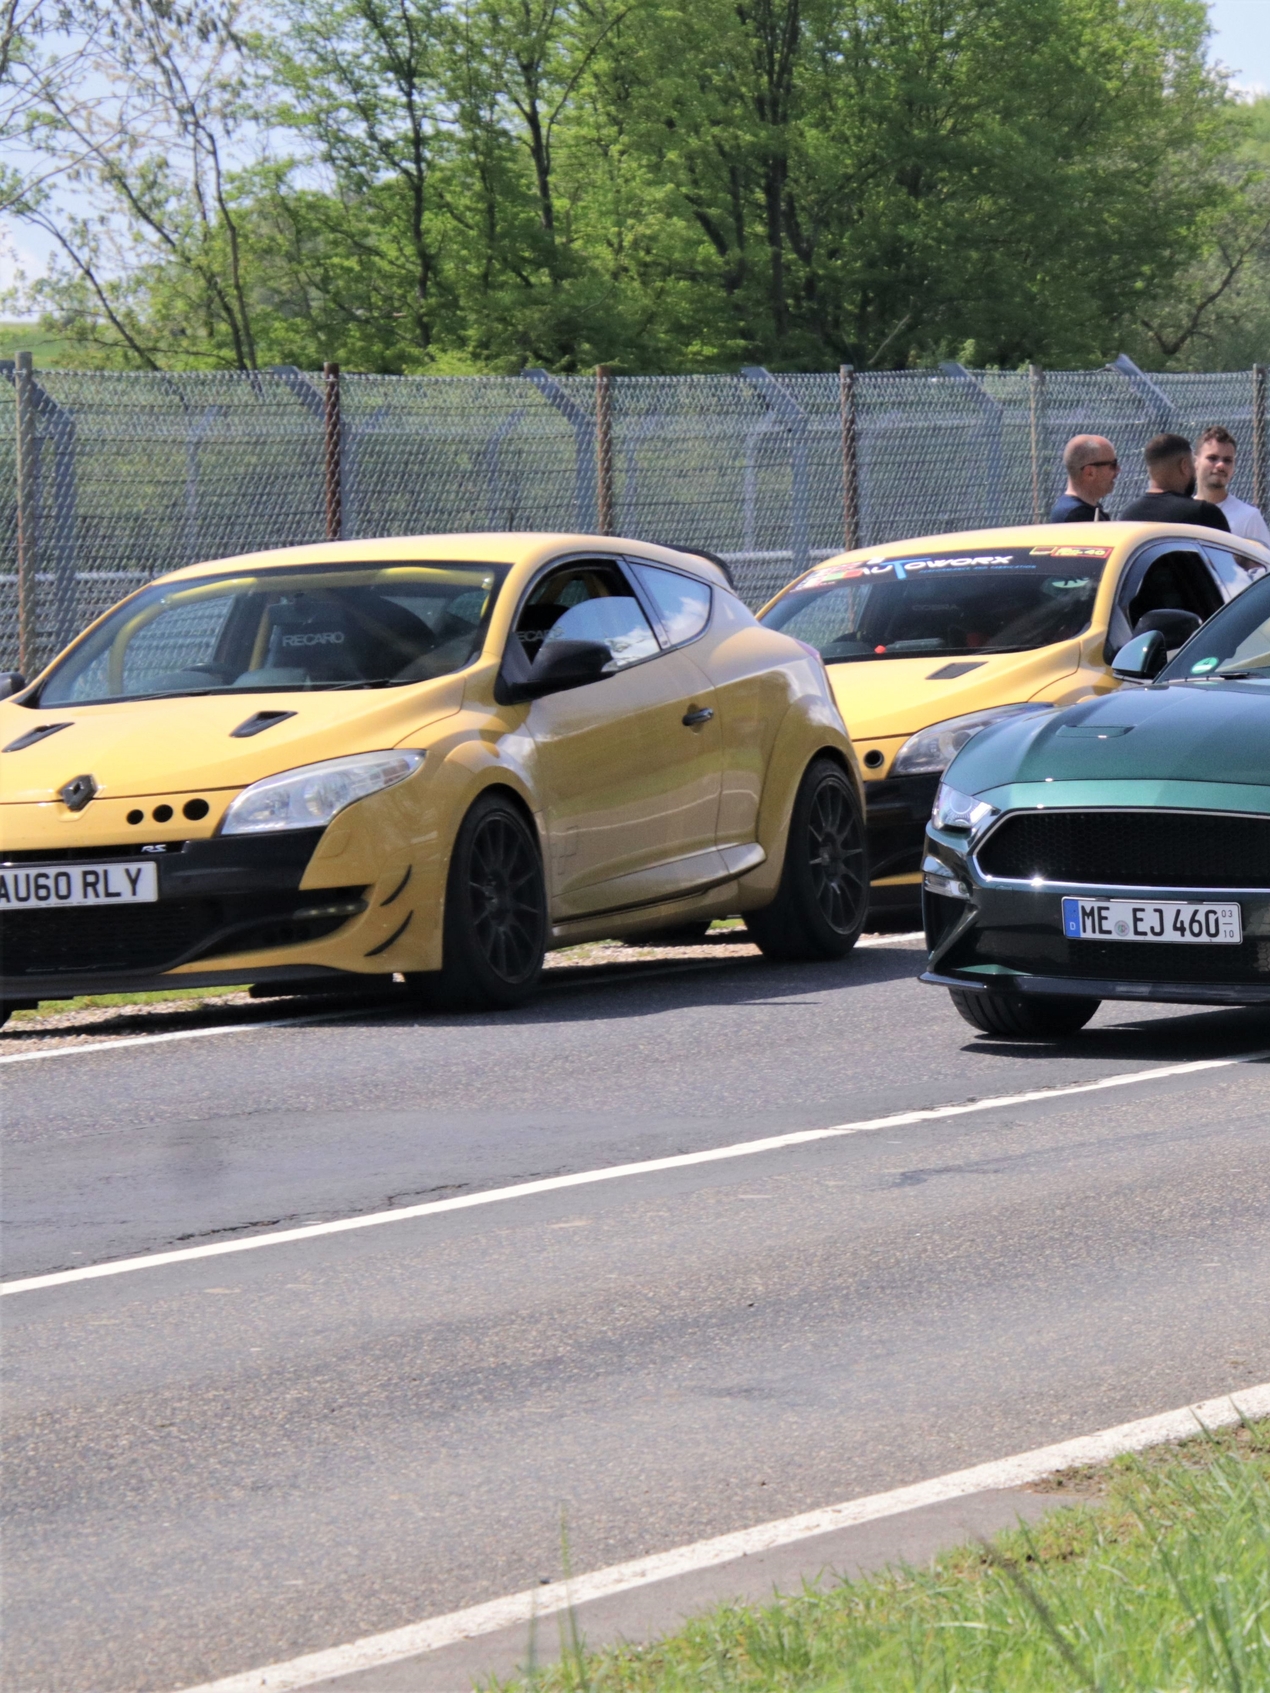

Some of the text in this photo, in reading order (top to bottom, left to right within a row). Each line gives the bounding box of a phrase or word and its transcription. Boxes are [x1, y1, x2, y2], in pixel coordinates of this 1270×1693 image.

[283, 631, 345, 647] RECARO
[141, 844, 167, 853] RS
[0, 867, 142, 903] AU60 RLY
[1221, 909, 1234, 919] 03
[1069, 921, 1077, 931] D
[1081, 905, 1220, 938] ME EJ 460
